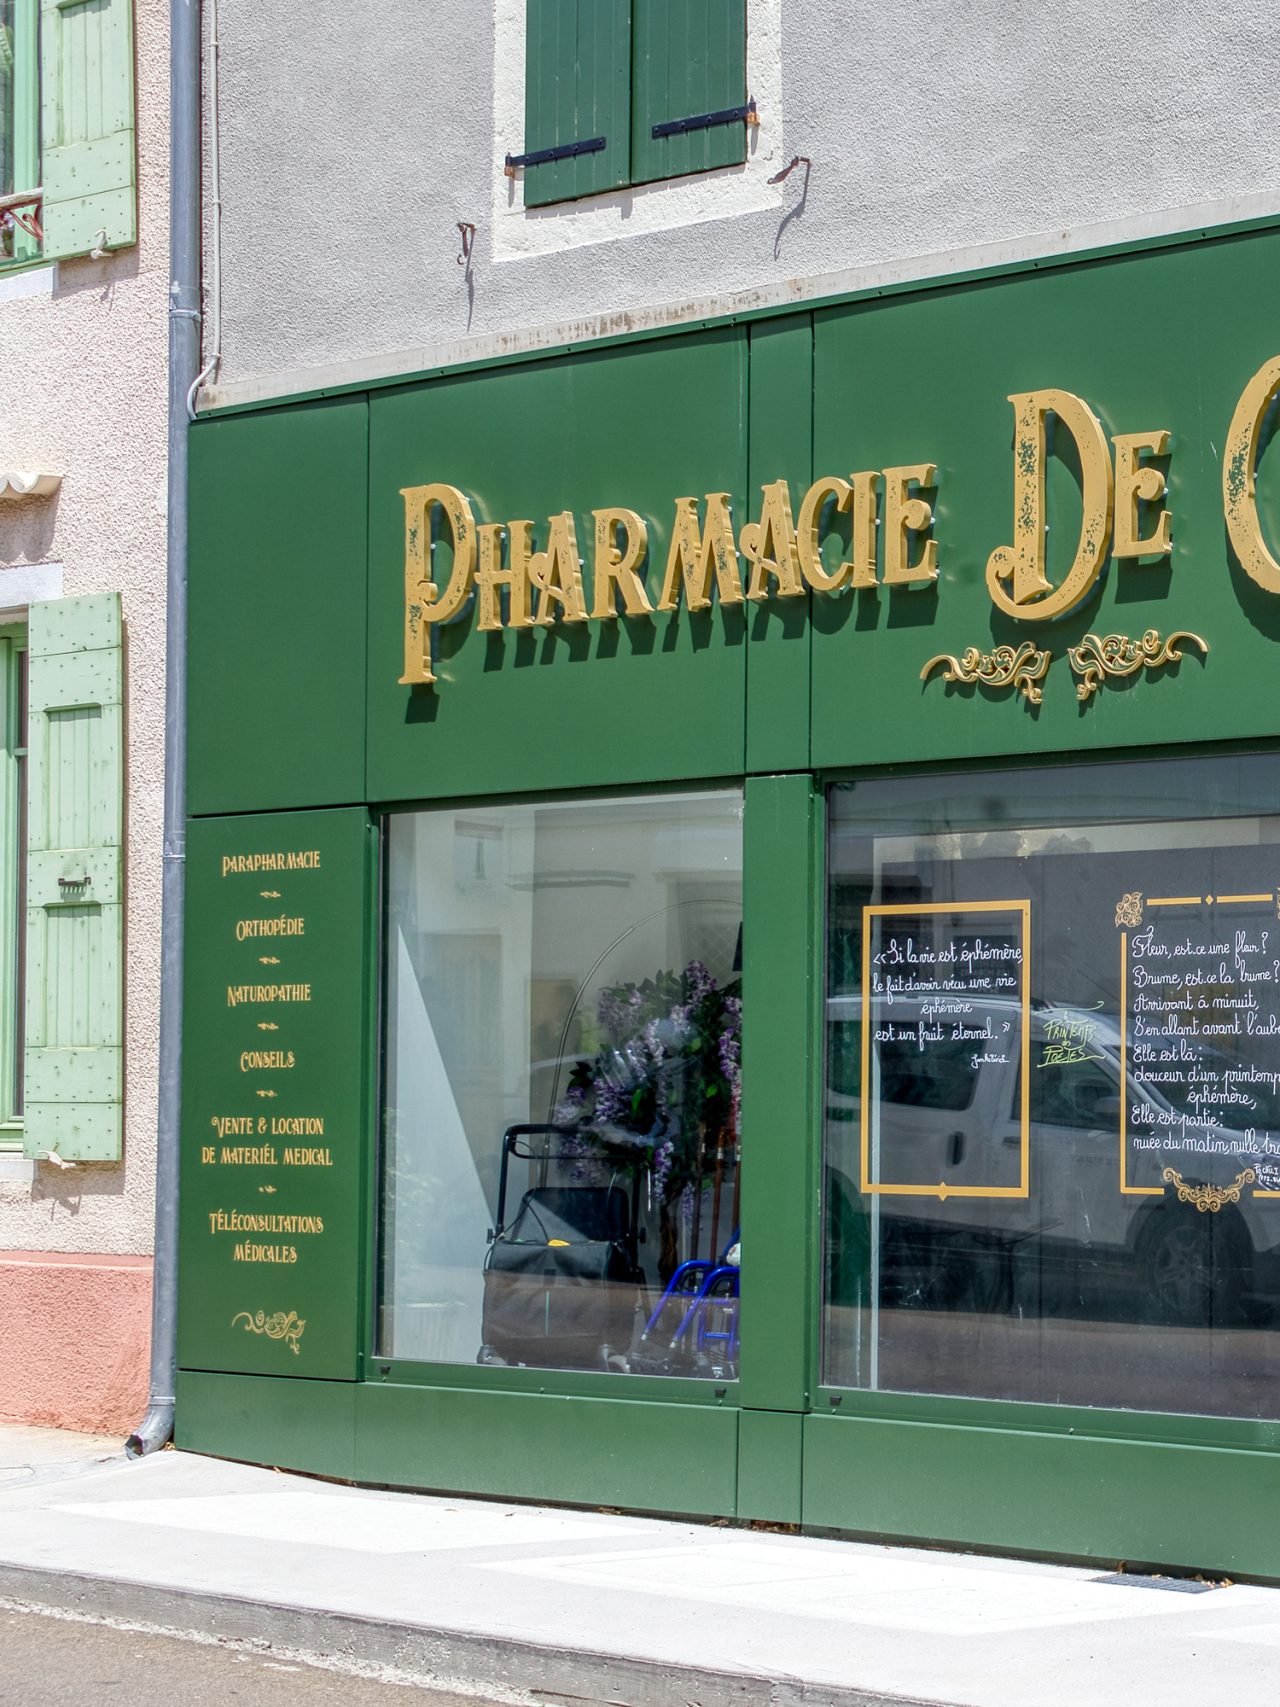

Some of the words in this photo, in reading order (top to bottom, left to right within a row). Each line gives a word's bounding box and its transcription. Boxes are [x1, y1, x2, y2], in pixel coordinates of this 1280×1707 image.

[399, 464, 939, 686] PHARMACIE
[986, 388, 1174, 621] DE
[222, 851, 321, 877] PARAPHARMACIE
[236, 914, 305, 941] ORTHOPÉDIE
[907, 938, 918, 963] la
[919, 946, 936, 963] vie
[938, 941, 958, 963] est
[1207, 943, 1230, 955] une
[873, 972, 884, 992] le
[886, 975, 904, 1005] fait
[943, 974, 967, 990] vécu
[968, 978, 991, 989] une
[995, 973, 1017, 987] vie
[1132, 965, 1183, 991] Brume,
[1220, 962, 1235, 984] la
[227, 984, 312, 1007] NATUROPATHIE
[1133, 988, 1194, 1012] Arrivant
[1212, 988, 1259, 1011] minuit,
[920, 997, 973, 1024] éphémère
[874, 1023, 895, 1041] est
[897, 1029, 917, 1041] un
[1161, 1013, 1200, 1036] allant
[1202, 1012, 1242, 1035] avant
[240, 1051, 295, 1072] CONSEILS
[1132, 1042, 1156, 1063] Elle
[1158, 1044, 1179, 1062] est
[1134, 1065, 1185, 1083] douceur
[1187, 1063, 1219, 1083] d'un
[1131, 1103, 1155, 1125] Elle
[1156, 1105, 1177, 1126] est
[211, 1116, 253, 1138] VENTE
[258, 1117, 267, 1134] &
[272, 1117, 324, 1135] LOCATION
[1133, 1131, 1162, 1150] nuée
[1162, 1131, 1181, 1150] du
[1230, 1128, 1261, 1154] nulle
[202, 1147, 216, 1164] DE
[283, 1148, 333, 1166] MEDICAL
[209, 1209, 324, 1234] TÉLÉCONSULTATIONS
[233, 1240, 297, 1263] MÉDICALES
